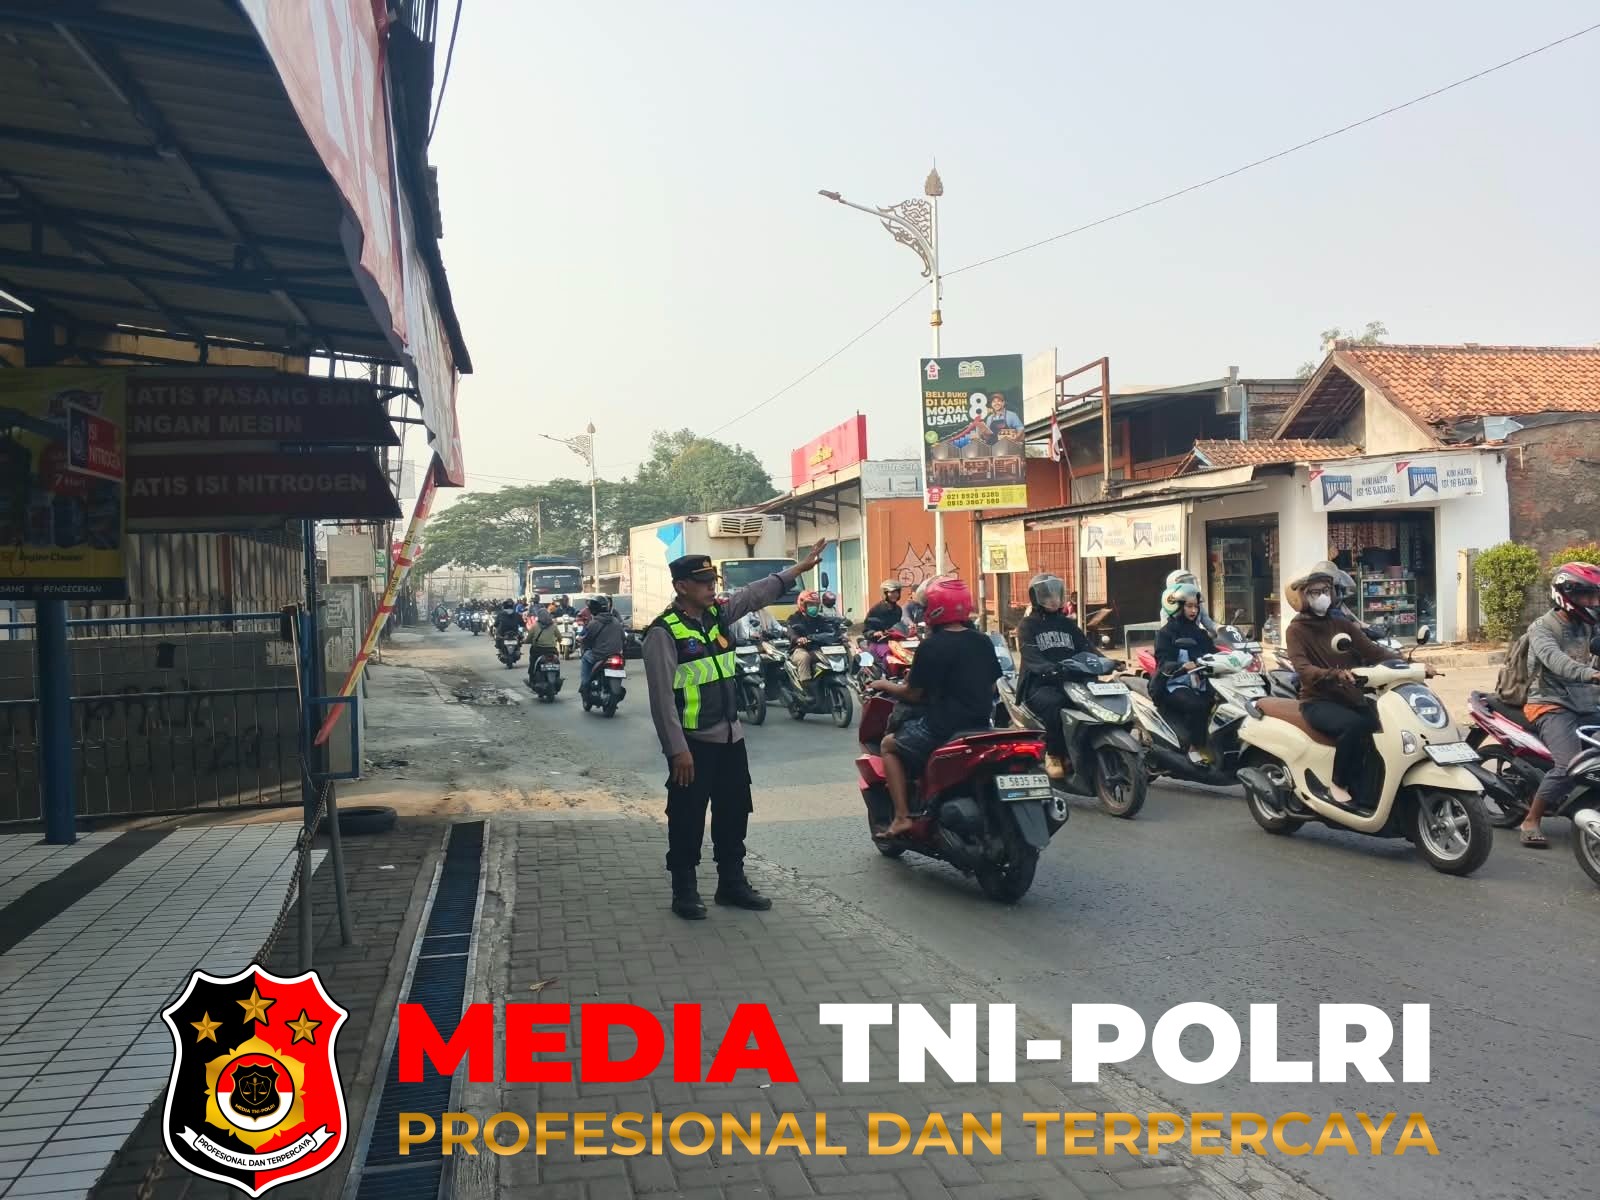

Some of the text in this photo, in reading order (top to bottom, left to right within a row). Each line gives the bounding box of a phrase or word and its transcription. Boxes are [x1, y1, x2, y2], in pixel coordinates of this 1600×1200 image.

[203, 385, 309, 406] PASANG
[926, 406, 968, 416] MODAL
[969, 393, 988, 420] 8
[128, 415, 303, 433] NGAN MESIN
[927, 414, 968, 426] USAHA
[197, 475, 228, 493] ISI
[237, 473, 367, 493] NITROGEN
[1373, 485, 1396, 495] BATANG
[43, 585, 102, 593] PENGECEKAN
